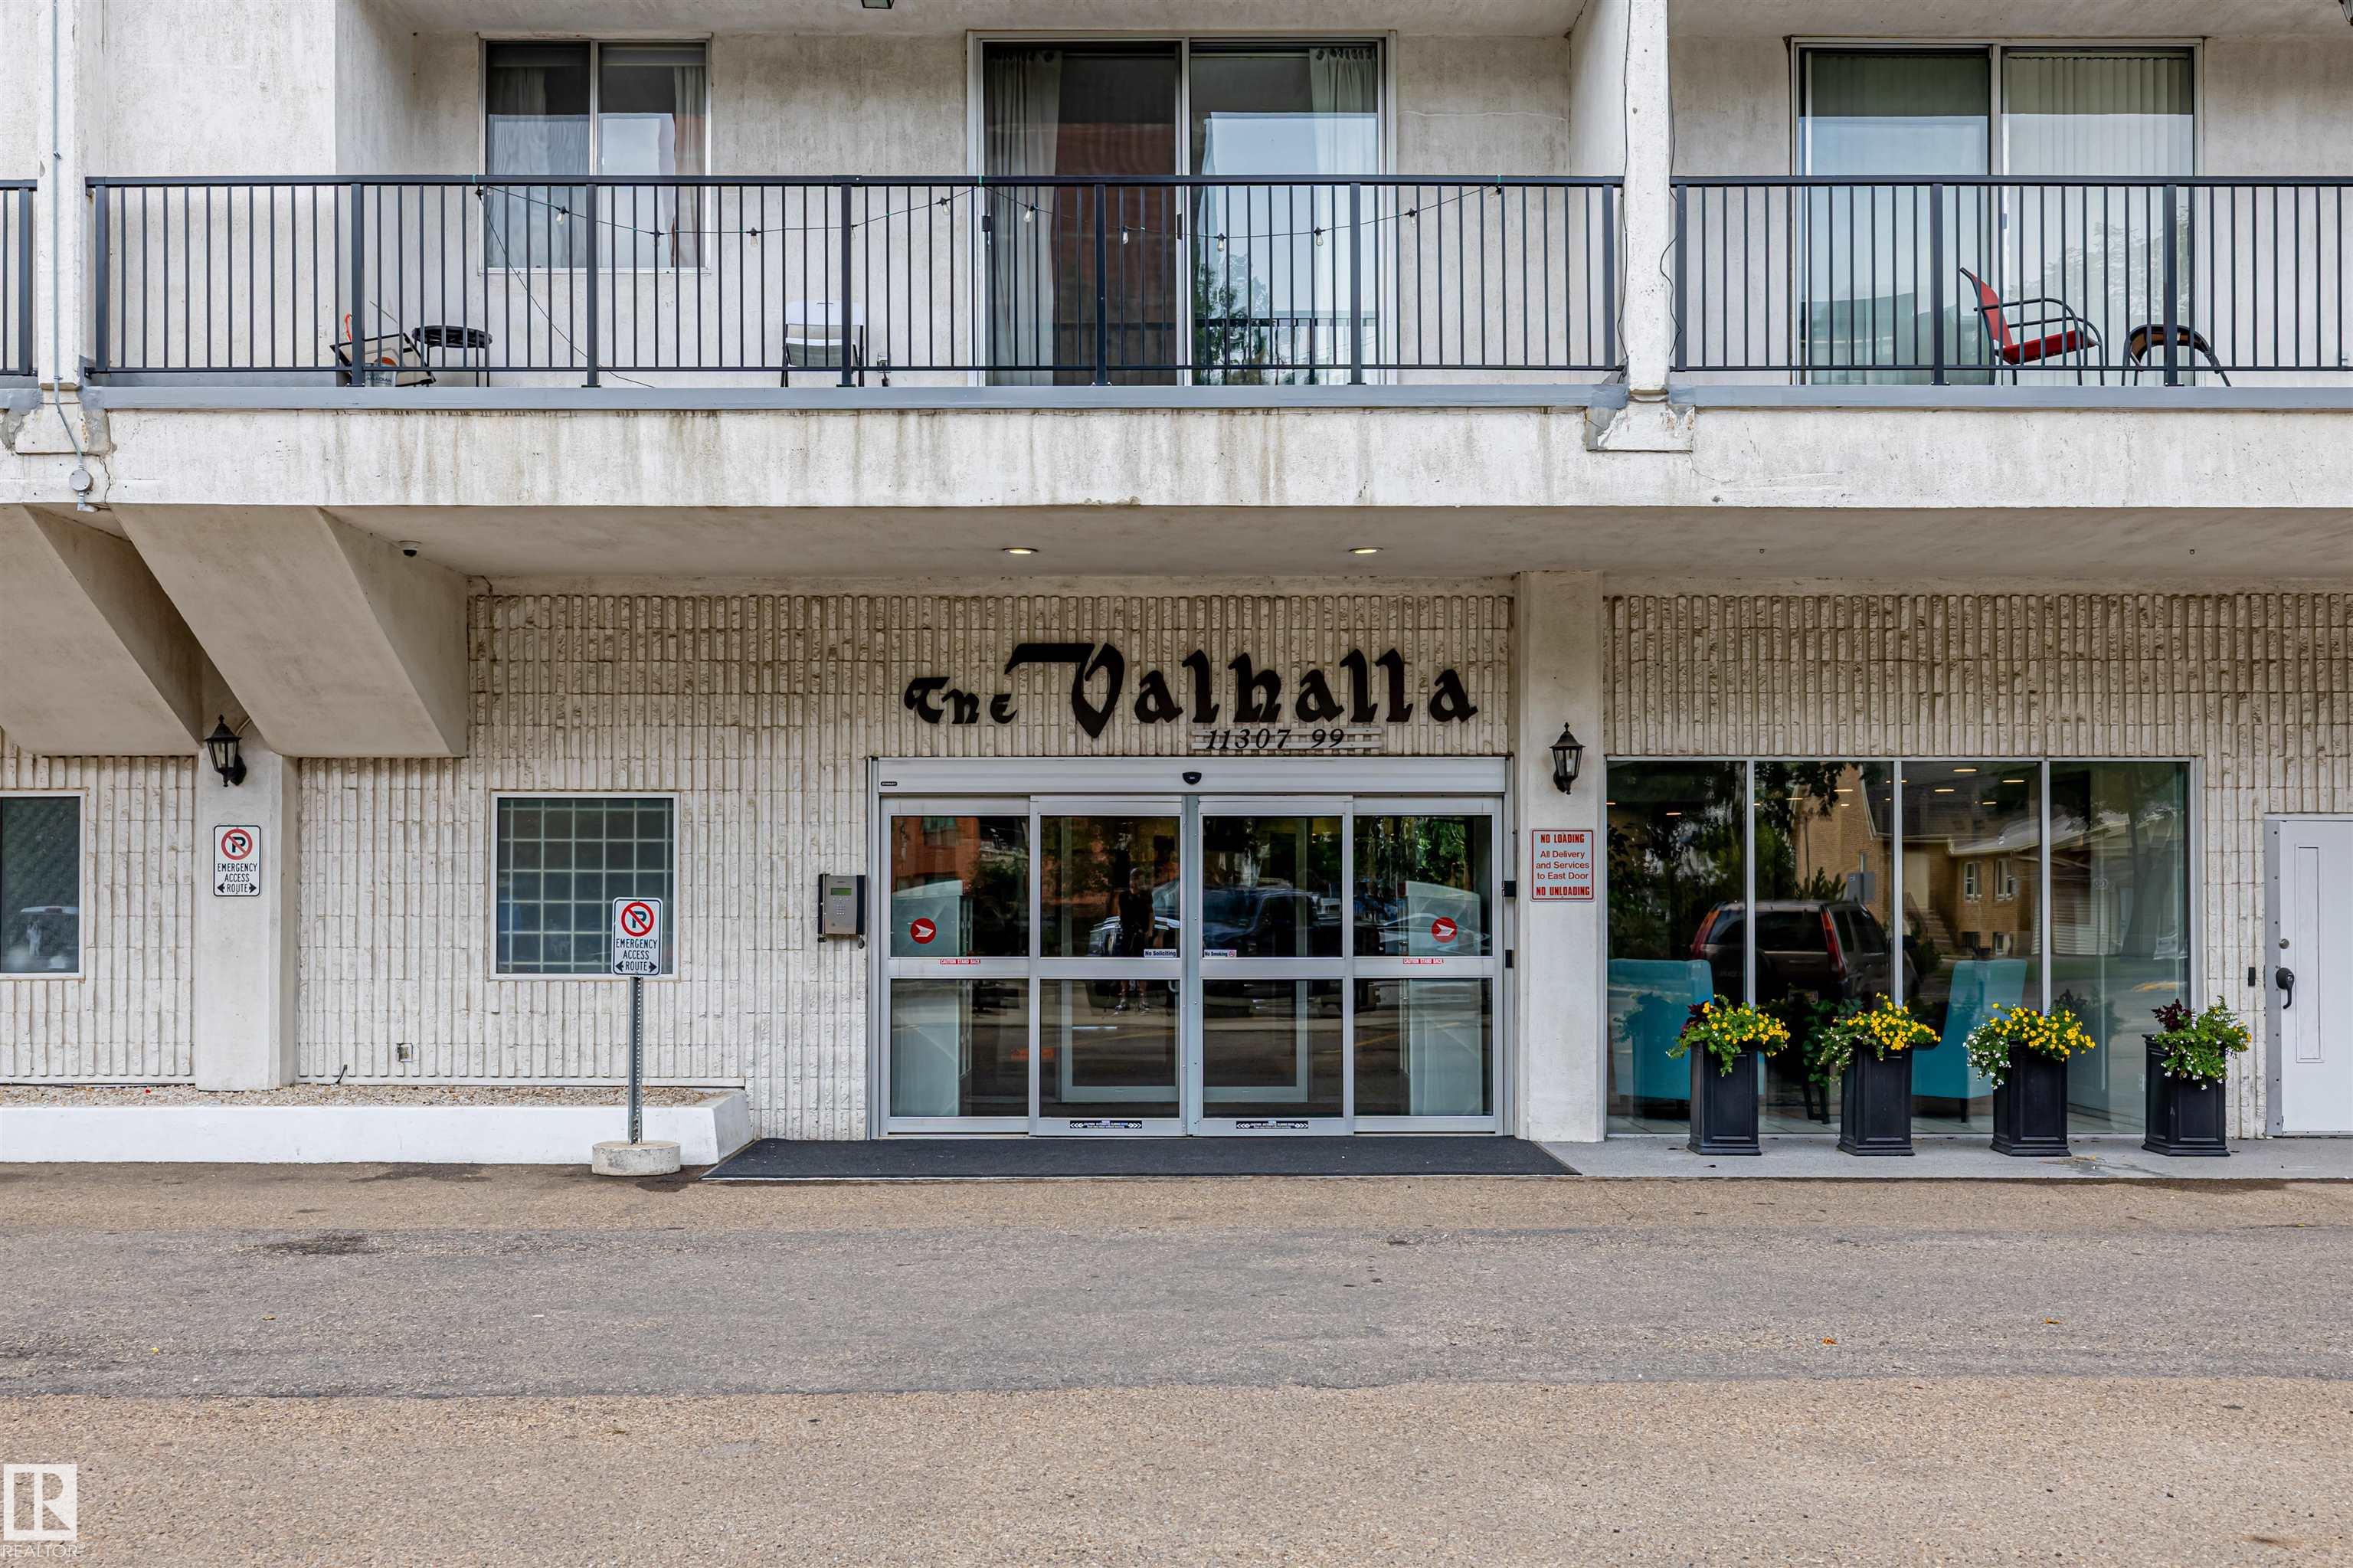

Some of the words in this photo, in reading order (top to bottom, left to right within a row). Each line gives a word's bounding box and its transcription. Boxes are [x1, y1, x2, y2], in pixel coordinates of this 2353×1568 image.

[1003, 642, 1478, 738] Valhalla
[1206, 728, 1291, 749] 11307
[1311, 728, 1345, 748] 99
[1540, 834, 1550, 843] NO
[1554, 834, 1585, 843] LOADING
[1553, 850, 1585, 859] Delivery
[217, 863, 257, 872] EMERGENCY
[224, 873, 250, 882] ACCESS
[1548, 872, 1566, 880] East
[1569, 872, 1589, 880] Door
[227, 883, 248, 893] ROUTE
[1536, 886, 1546, 896] NO
[1550, 886, 1590, 896] UNLOADING
[616, 938, 657, 949] EMERGENCY
[623, 950, 650, 960] ACCESS
[625, 961, 648, 971] ROUTE
